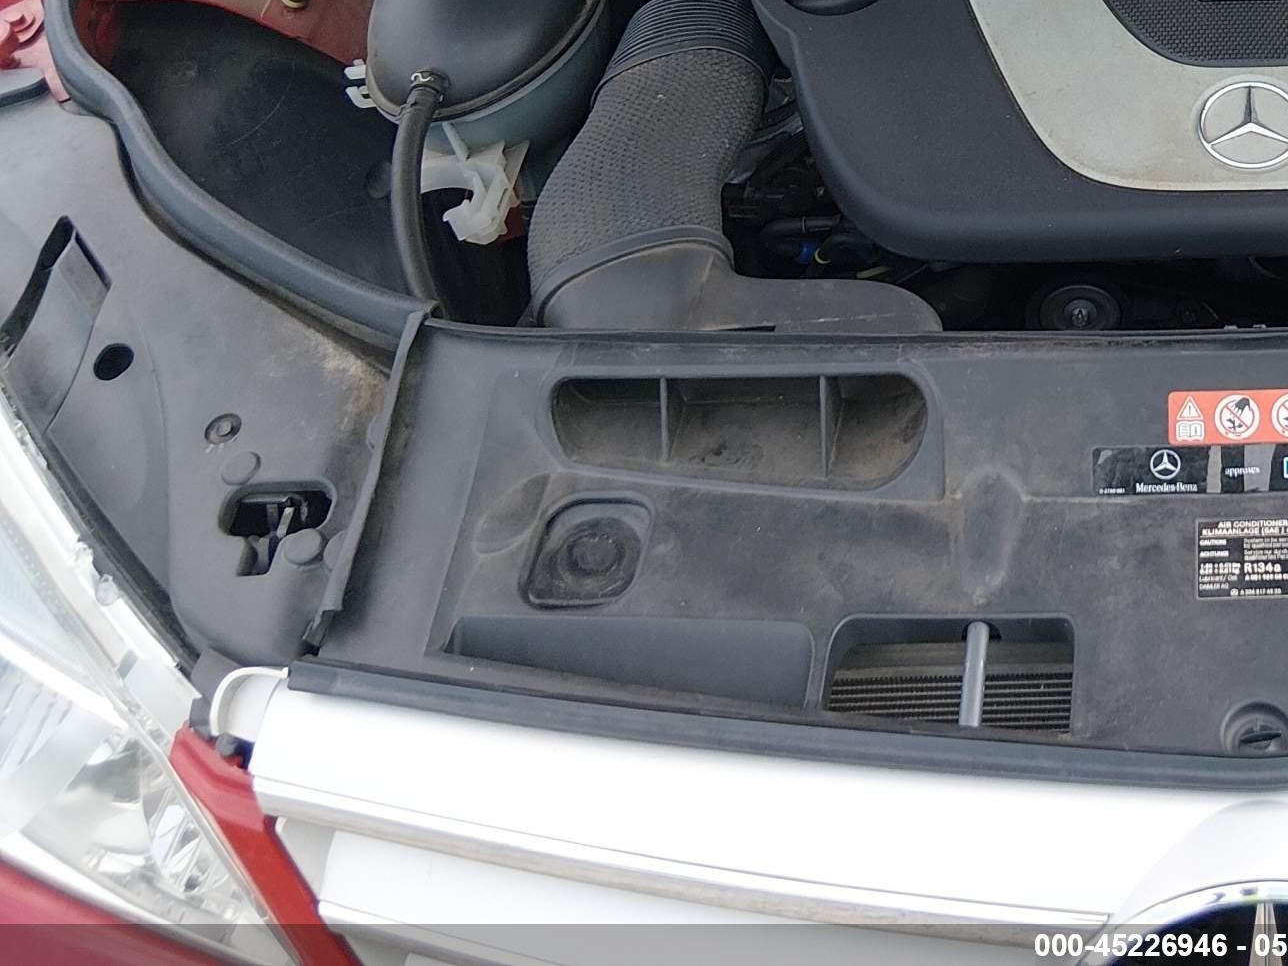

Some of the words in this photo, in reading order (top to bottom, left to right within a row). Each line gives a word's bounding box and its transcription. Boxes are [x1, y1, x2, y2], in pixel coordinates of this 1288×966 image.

[1135, 482, 1198, 494] Mercedes-Benz
[1218, 521, 1232, 529] AIR
[1233, 520, 1288, 528] CONDITIONER
[1243, 562, 1282, 573] R134a
